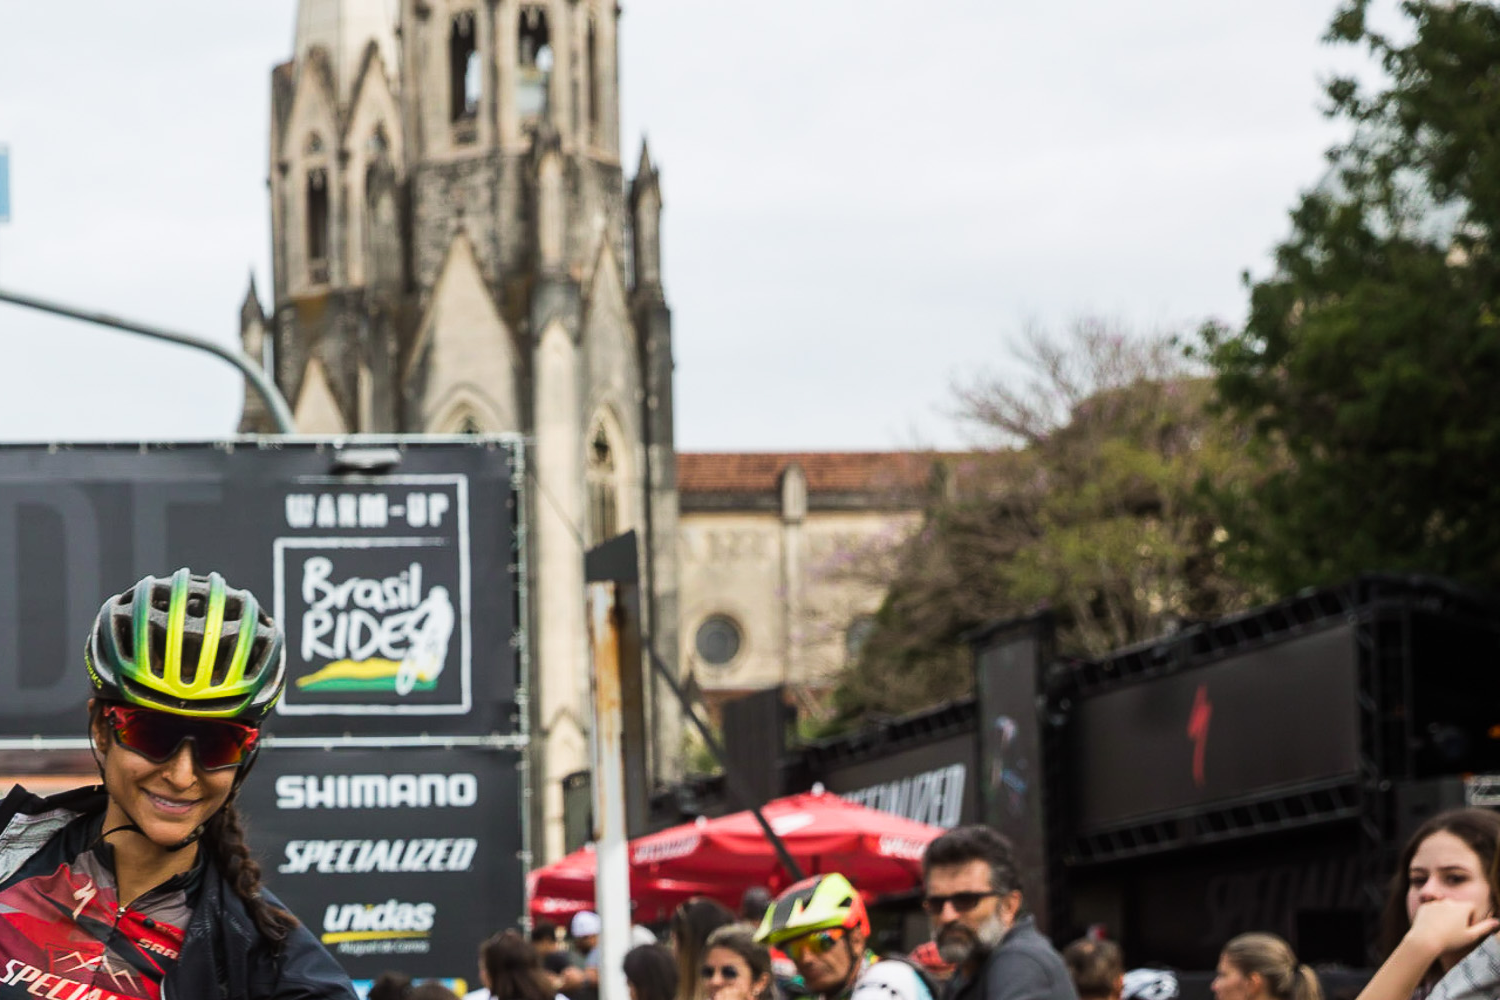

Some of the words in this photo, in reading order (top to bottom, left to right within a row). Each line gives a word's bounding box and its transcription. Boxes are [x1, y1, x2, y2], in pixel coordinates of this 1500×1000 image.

[285, 492, 450, 529] WARM-UP
[301, 556, 422, 612] Brasil
[275, 773, 477, 809] SHIMANO
[278, 838, 477, 873] SPECIALIZED
[323, 898, 436, 932] unidas
